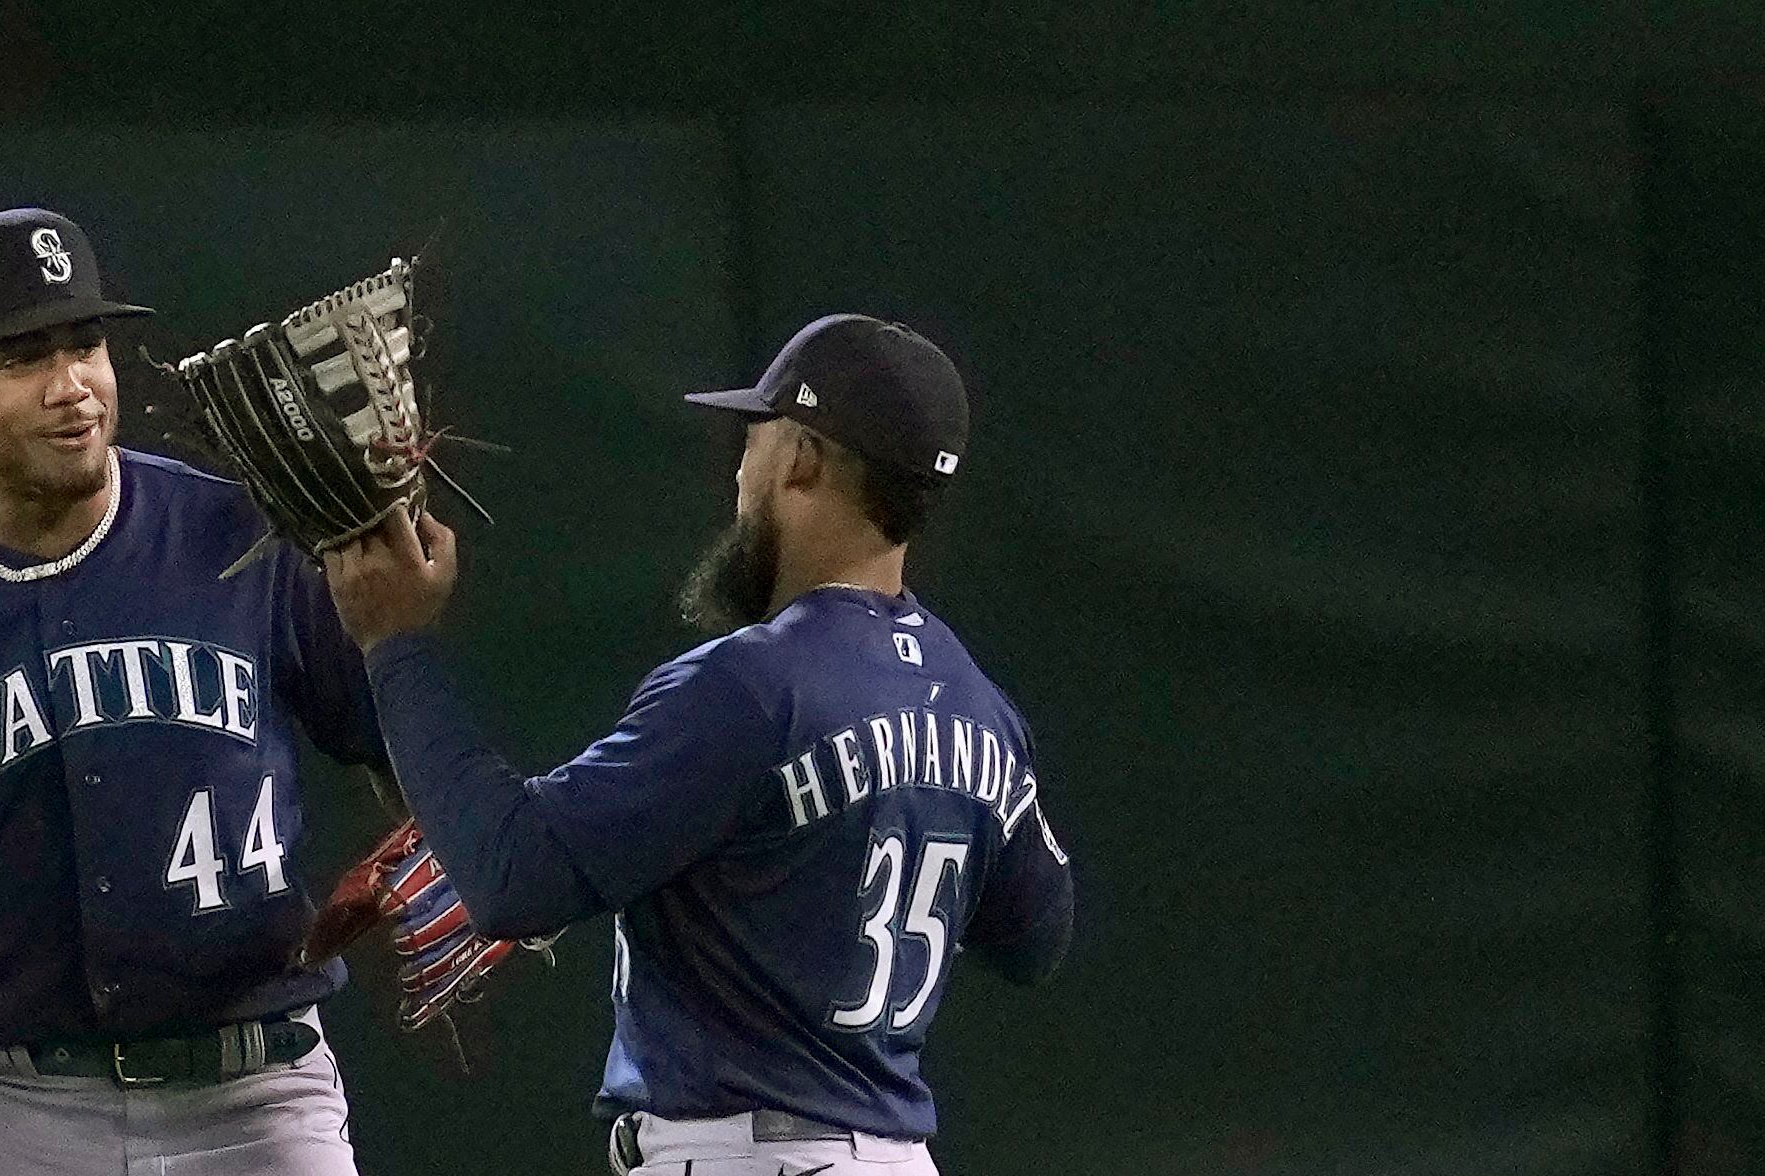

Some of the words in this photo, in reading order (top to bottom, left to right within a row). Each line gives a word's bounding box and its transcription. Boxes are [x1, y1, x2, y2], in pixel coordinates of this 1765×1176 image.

[268, 377, 315, 441] A2000
[166, 773, 290, 911] 44
[831, 835, 971, 1030] 35
